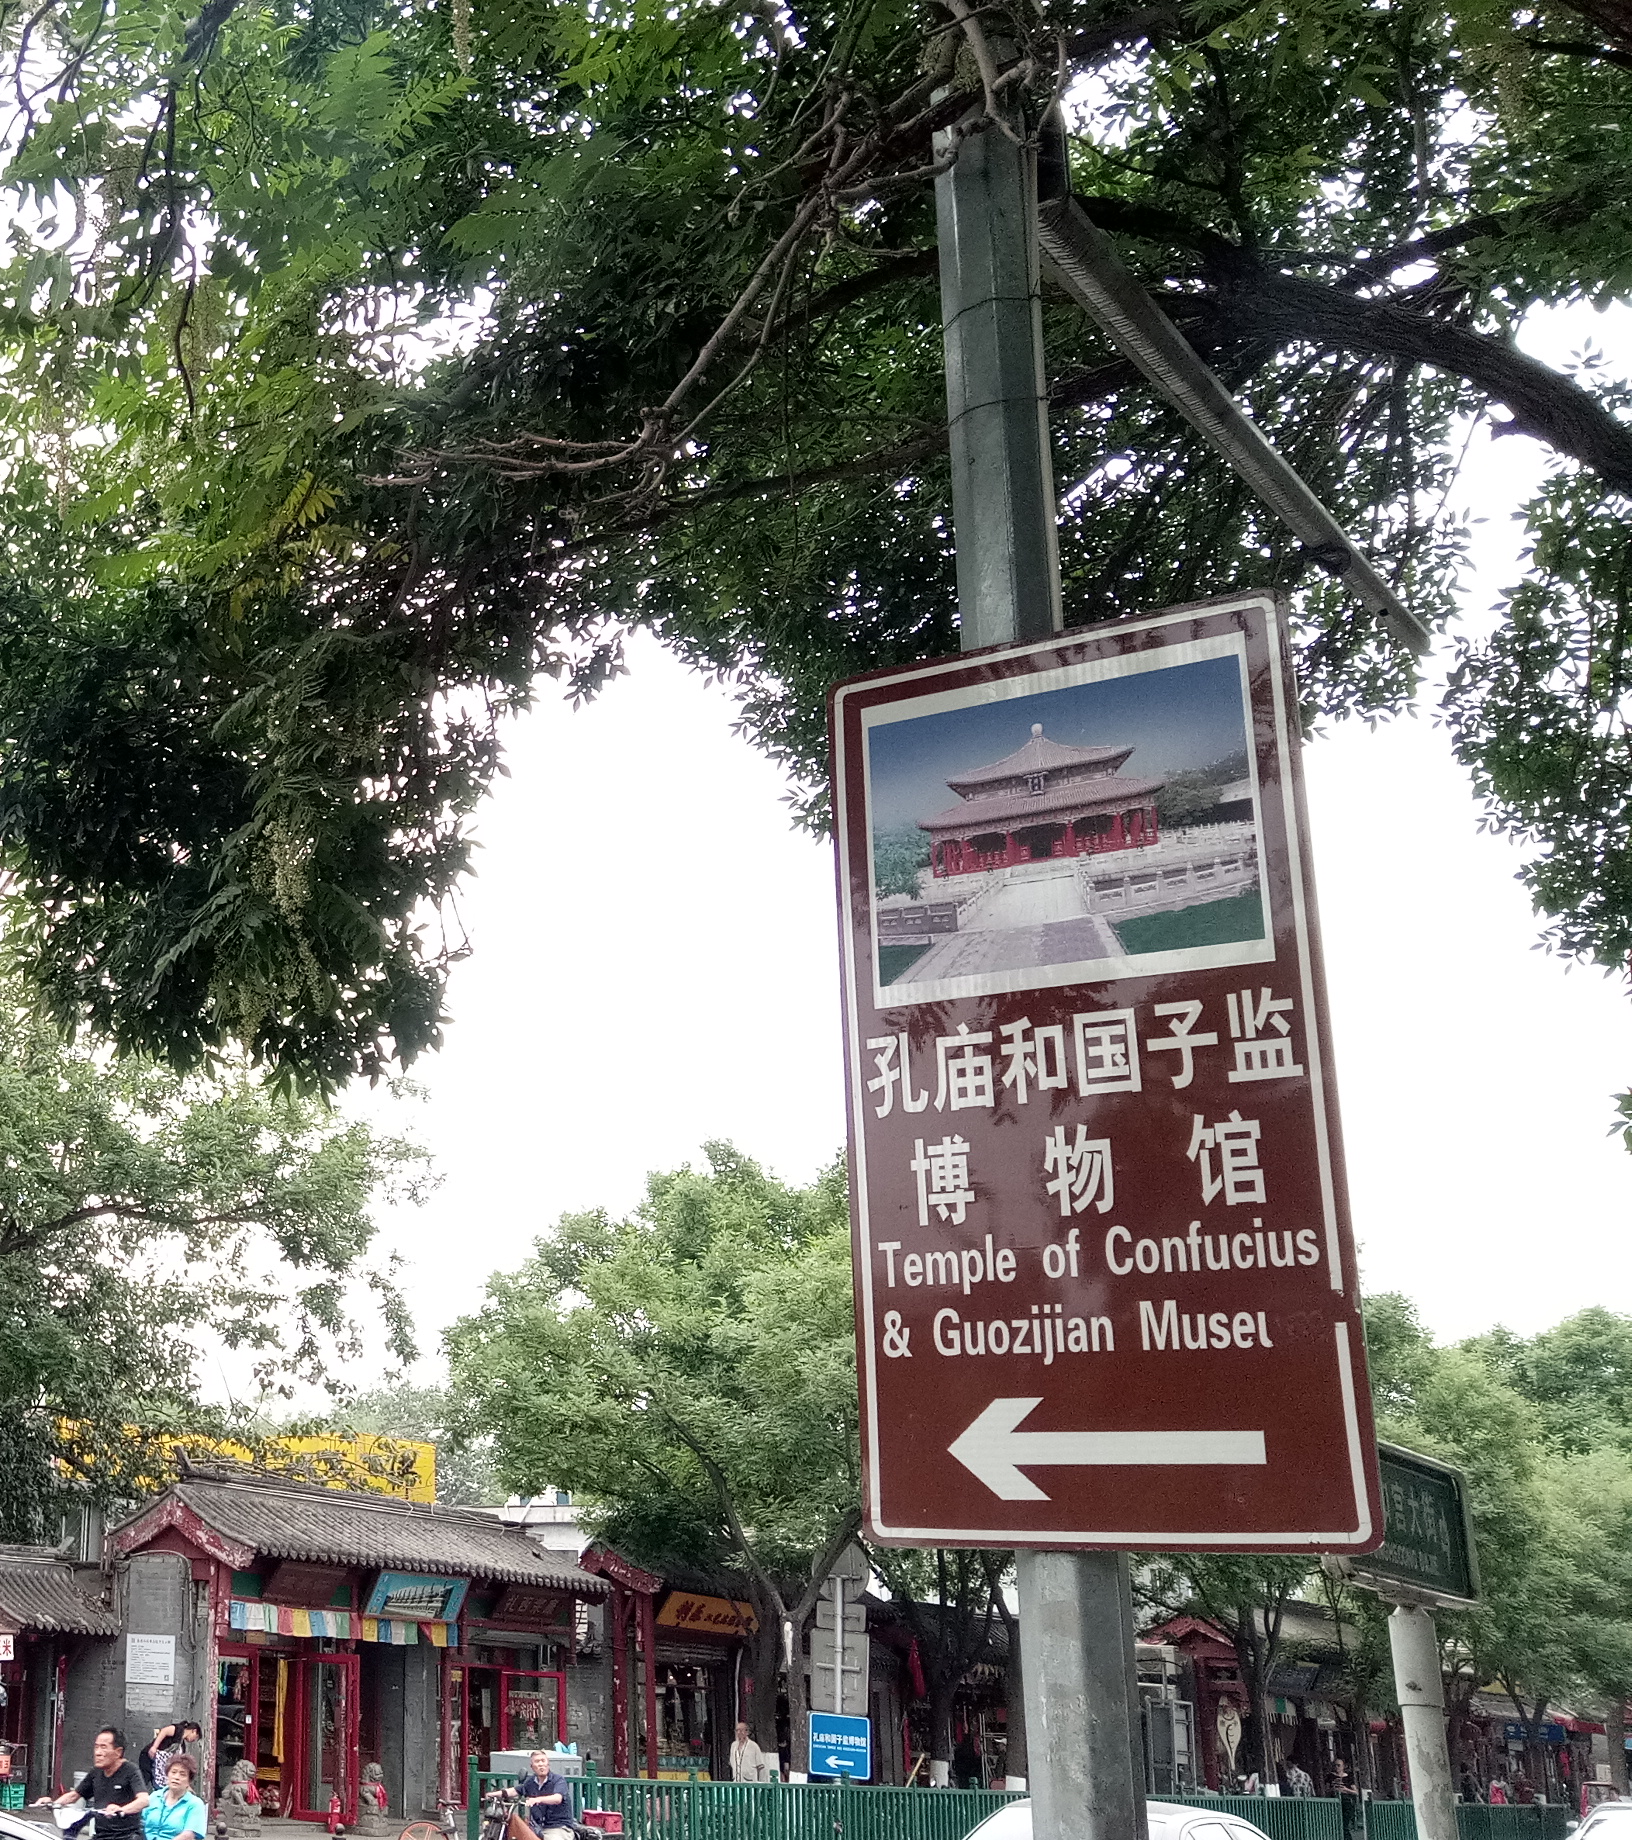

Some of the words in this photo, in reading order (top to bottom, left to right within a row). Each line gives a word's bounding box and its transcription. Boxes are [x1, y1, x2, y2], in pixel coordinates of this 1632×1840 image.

[866, 987, 1304, 1119] 孔庙和国子监
[910, 1110, 1266, 1227] 博物馆
[878, 1234, 1016, 1294] Temple
[1042, 1228, 1080, 1279] of
[1105, 1218, 1320, 1275] Confucius
[882, 1310, 912, 1358] &
[933, 1304, 1115, 1366] Guozijian
